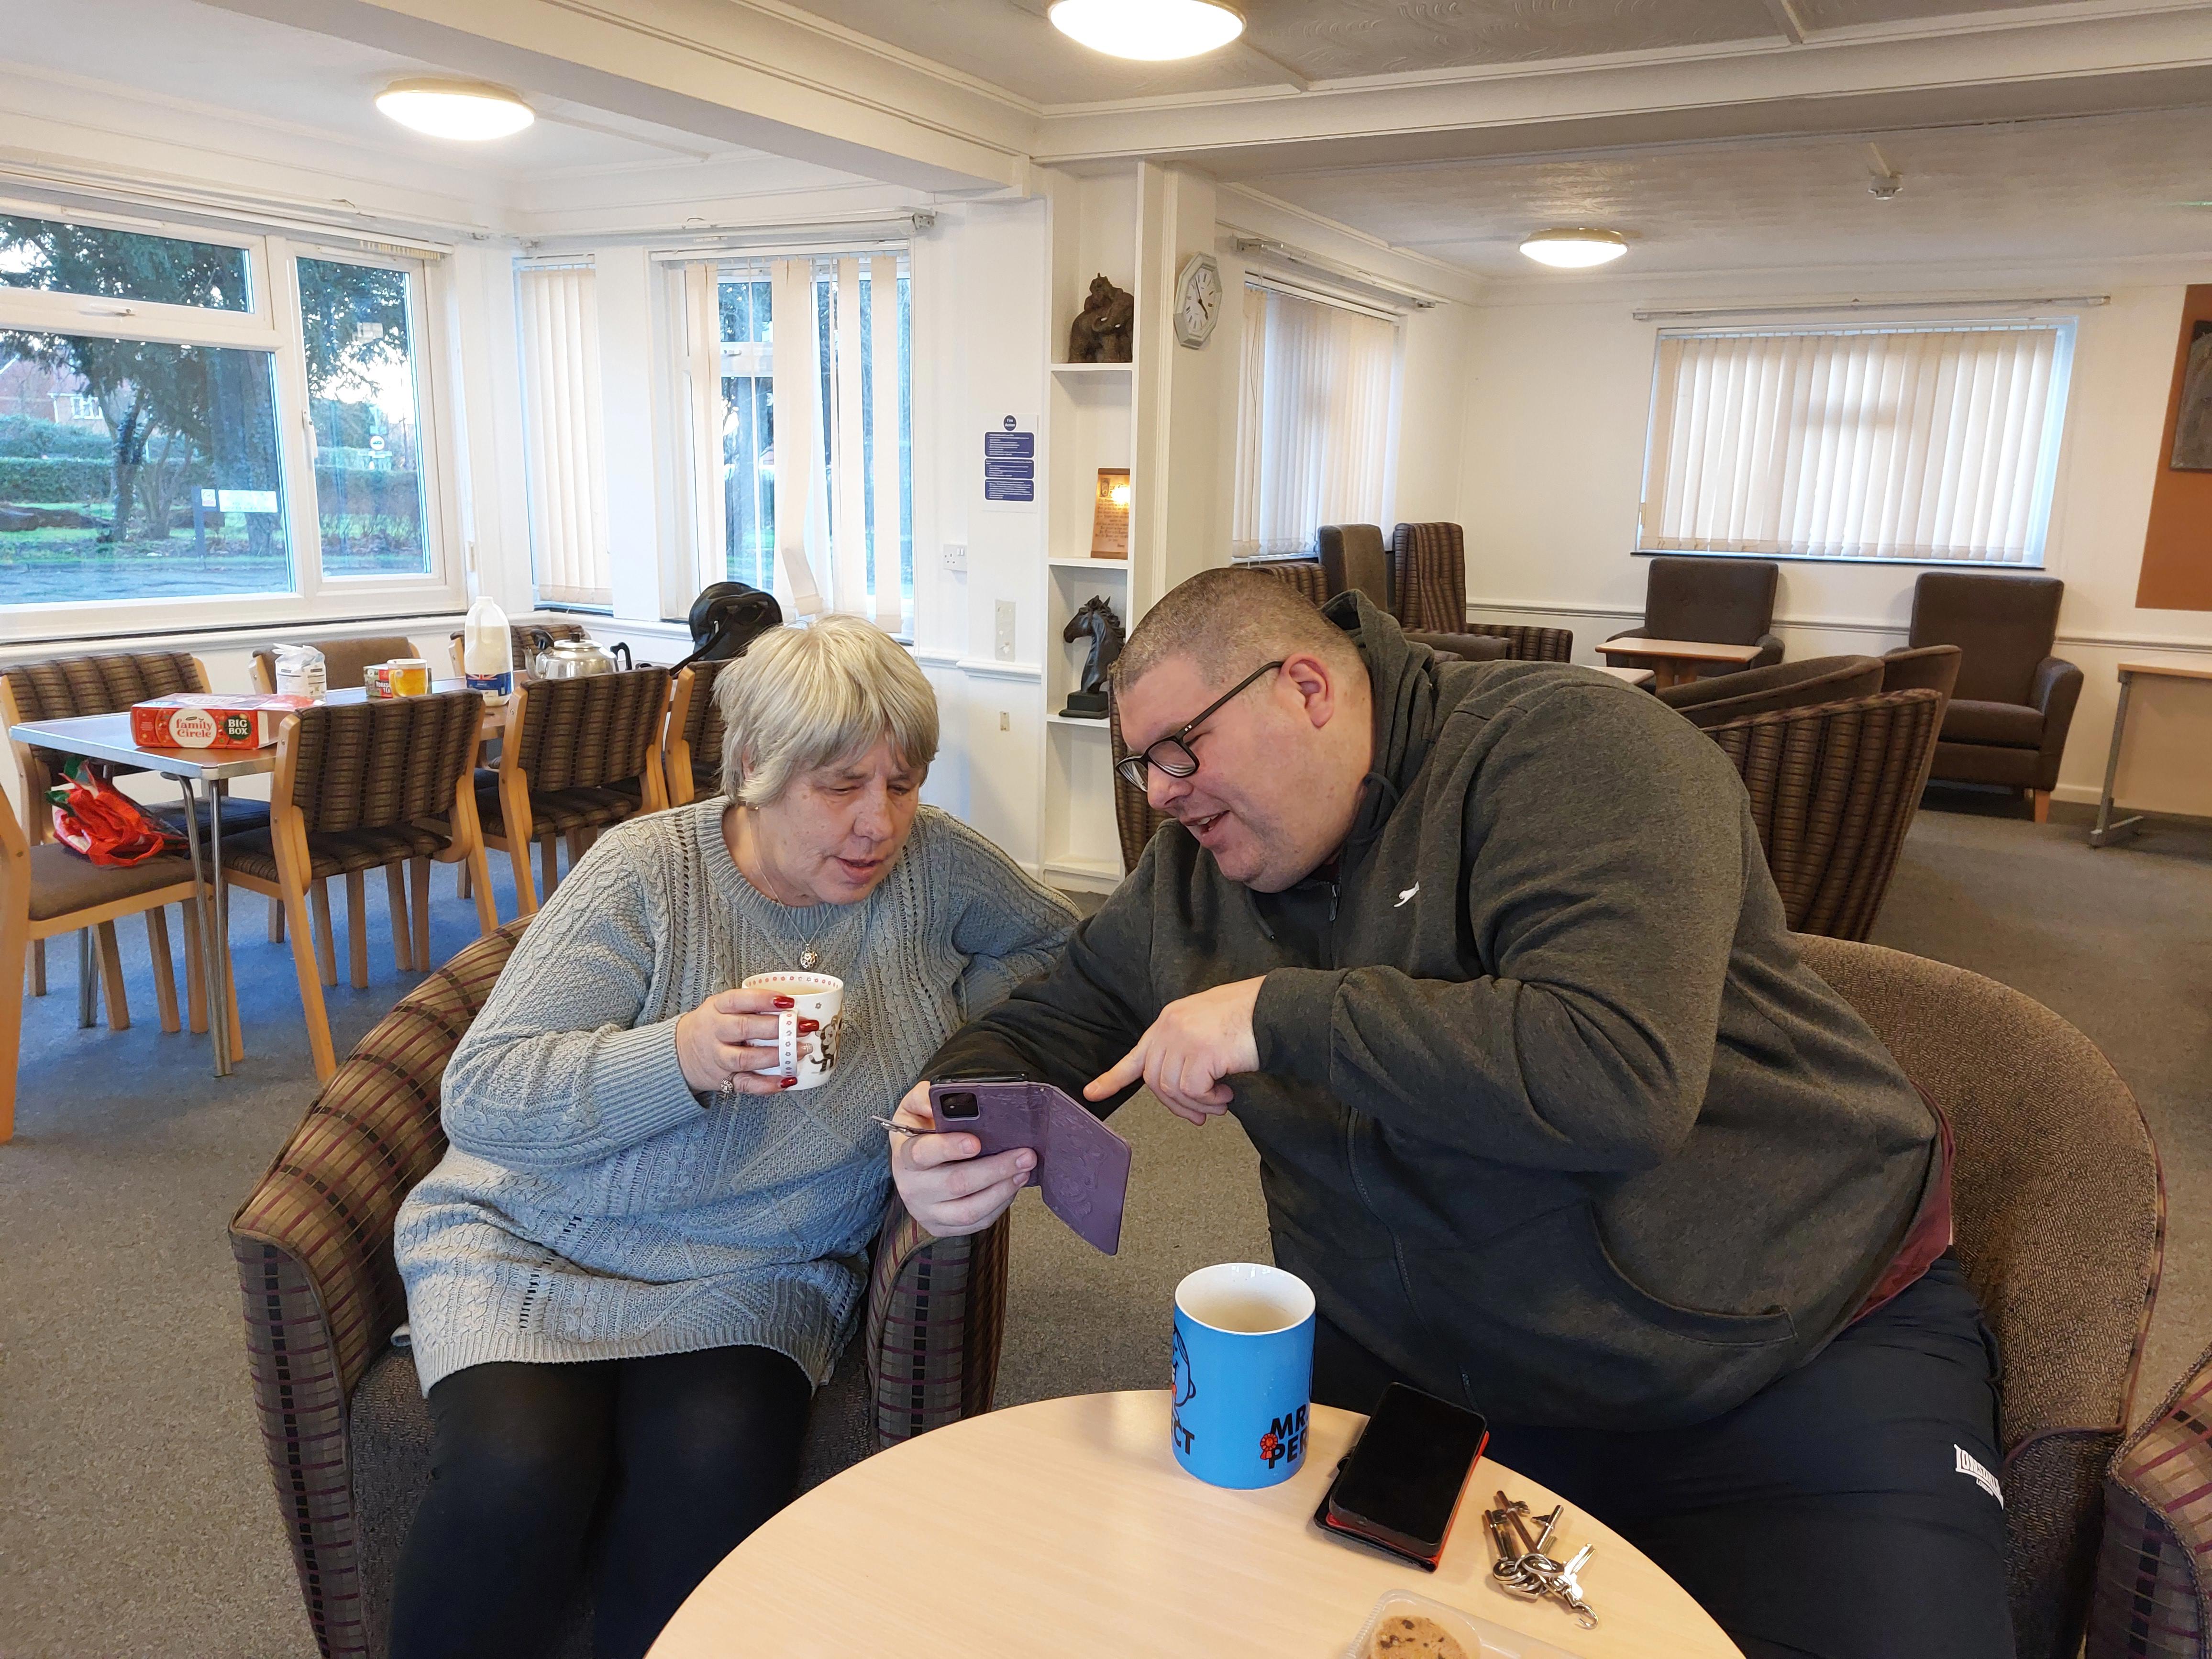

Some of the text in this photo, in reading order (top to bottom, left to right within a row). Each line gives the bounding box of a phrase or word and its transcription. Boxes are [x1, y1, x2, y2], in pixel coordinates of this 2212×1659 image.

[176, 719, 213, 731] family
[228, 719, 247, 728] BIG
[177, 728, 212, 738] Circle
[228, 727, 248, 735] BOX
[1172, 1420, 1195, 1456] CT
